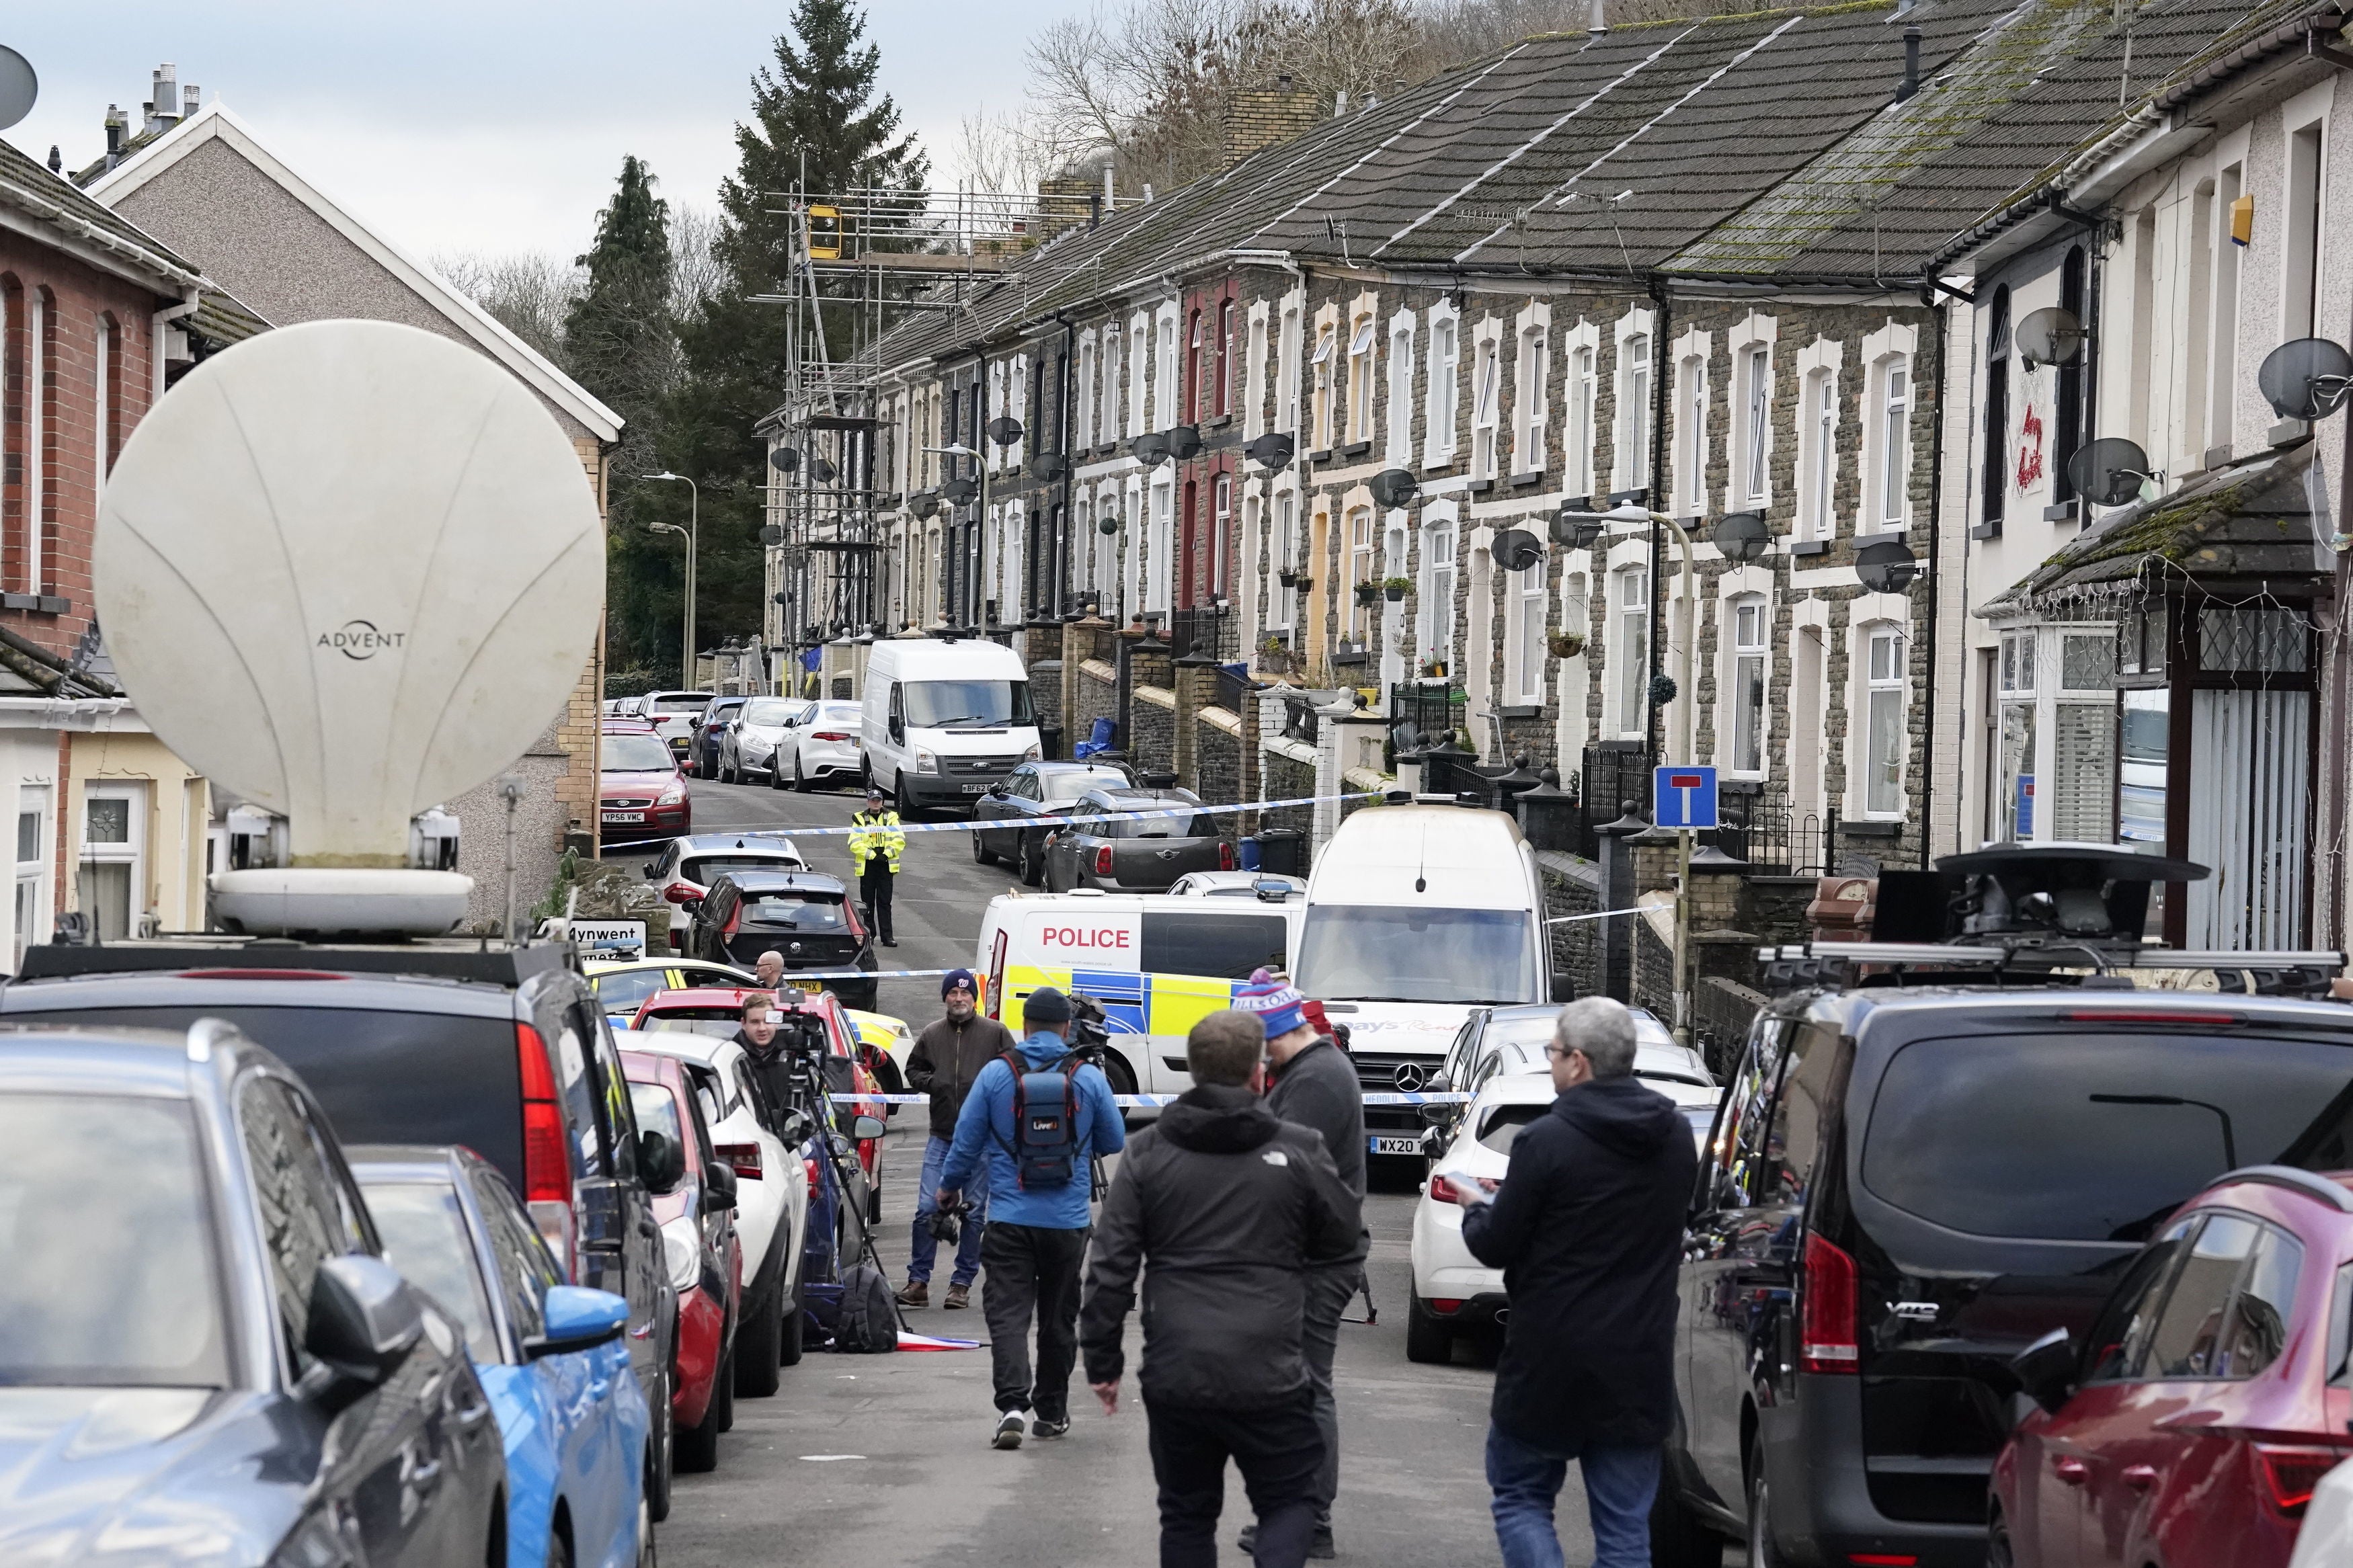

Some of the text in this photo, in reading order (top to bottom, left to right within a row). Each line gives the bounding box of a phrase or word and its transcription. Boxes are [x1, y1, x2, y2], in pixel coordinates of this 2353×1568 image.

[317, 632, 405, 647] ADVENT
[1043, 927, 1129, 948] POLICE
[799, 982, 817, 991] NHX
[1365, 1094, 1462, 1104] HEDDLU POLICE
[1380, 1139, 1412, 1153] WX20
[1886, 1301, 1940, 1314] VITO
